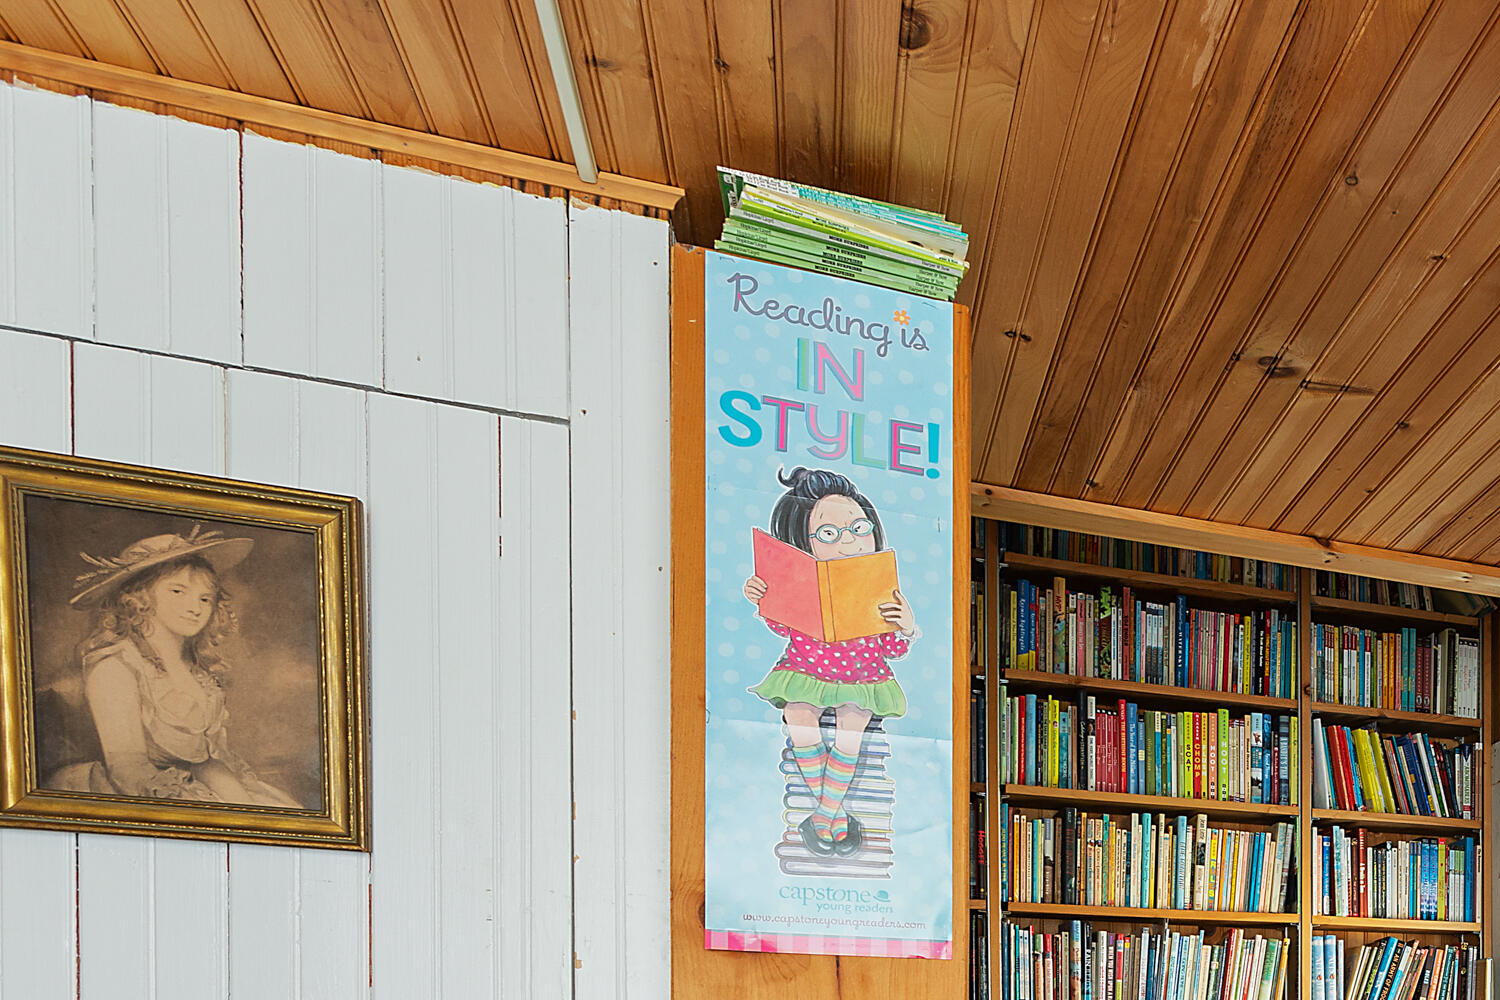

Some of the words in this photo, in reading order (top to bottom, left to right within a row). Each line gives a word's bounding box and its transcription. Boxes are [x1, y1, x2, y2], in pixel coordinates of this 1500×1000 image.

[727, 272, 893, 357] Reading
[900, 310, 931, 352] is
[796, 337, 865, 402] IN
[717, 390, 941, 480] STYLE!
[778, 884, 873, 907] capstone
[816, 902, 852, 914] young
[854, 902, 894, 913] readers
[742, 911, 927, 930] www.capstoneyoungreaders.com
